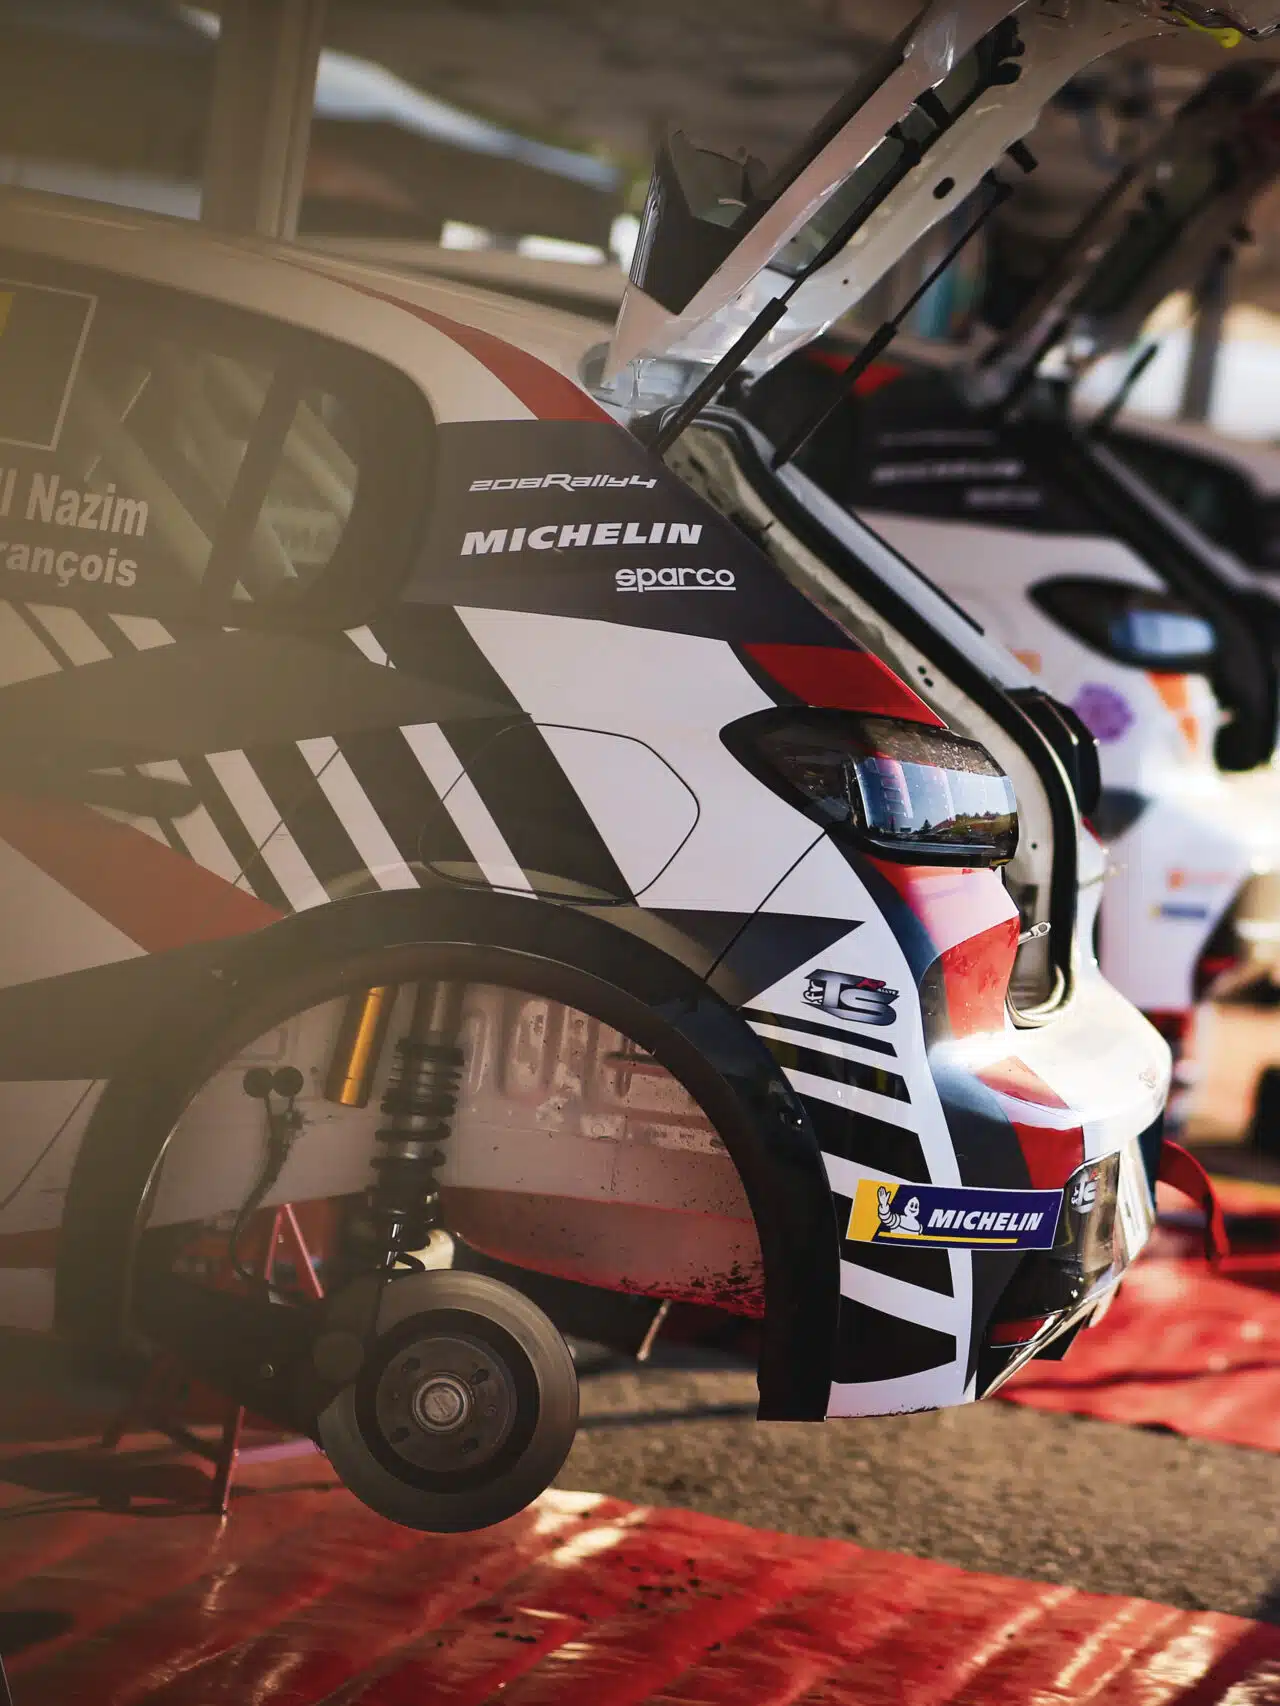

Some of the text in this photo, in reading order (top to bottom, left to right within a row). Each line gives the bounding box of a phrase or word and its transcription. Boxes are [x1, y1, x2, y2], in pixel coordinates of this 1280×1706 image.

[25, 472, 149, 537] Nazim
[460, 522, 702, 556] MICHELIN
[615, 567, 736, 593] sparco
[927, 1208, 1044, 1231] MICHELIN
